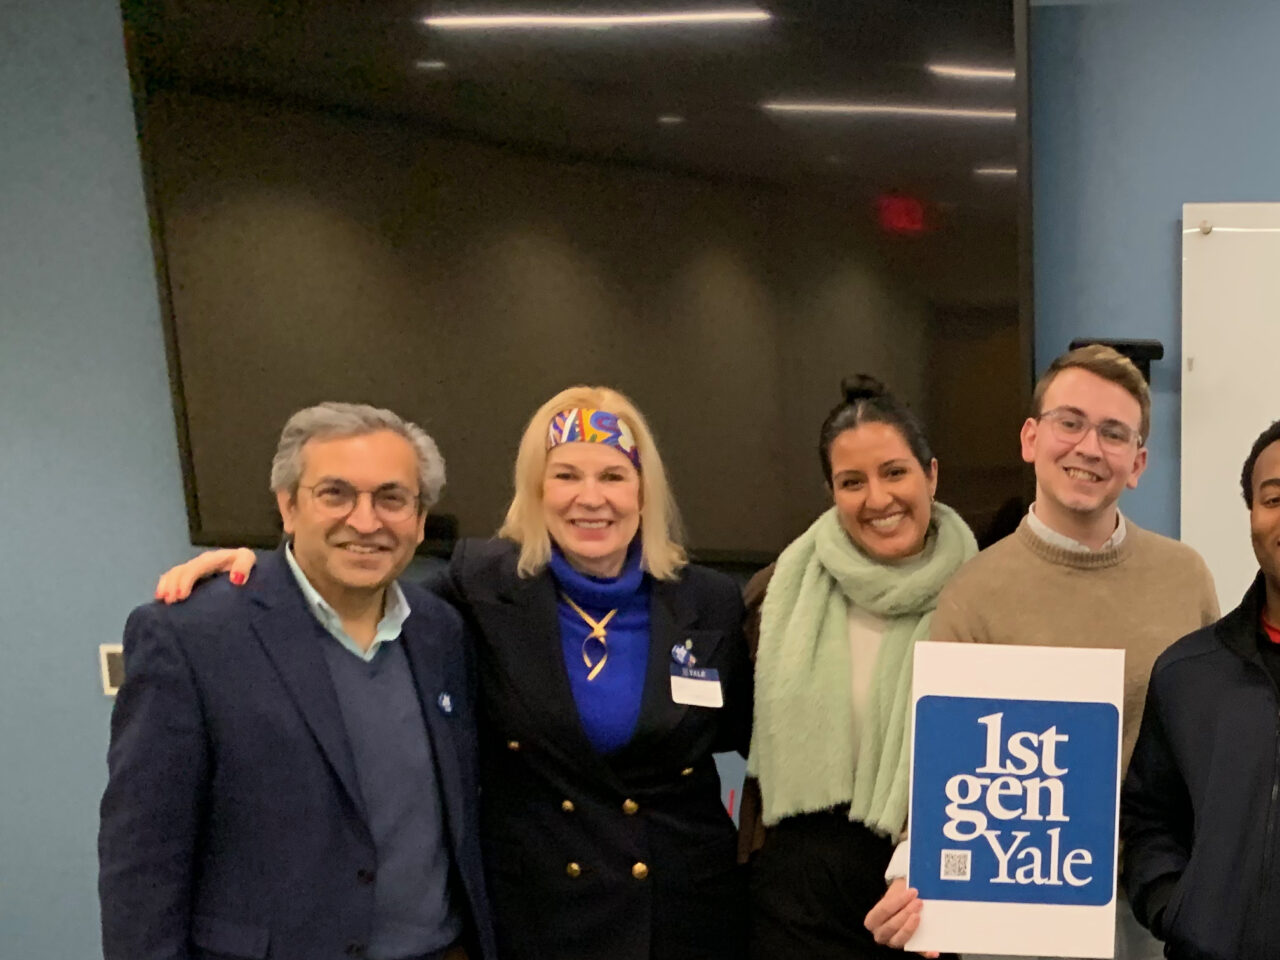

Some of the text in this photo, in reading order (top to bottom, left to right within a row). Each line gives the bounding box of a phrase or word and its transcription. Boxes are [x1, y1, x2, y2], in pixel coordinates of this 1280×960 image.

[976, 712, 1069, 776] 1st
[943, 774, 1070, 841] gen
[982, 827, 1093, 886] Yale
